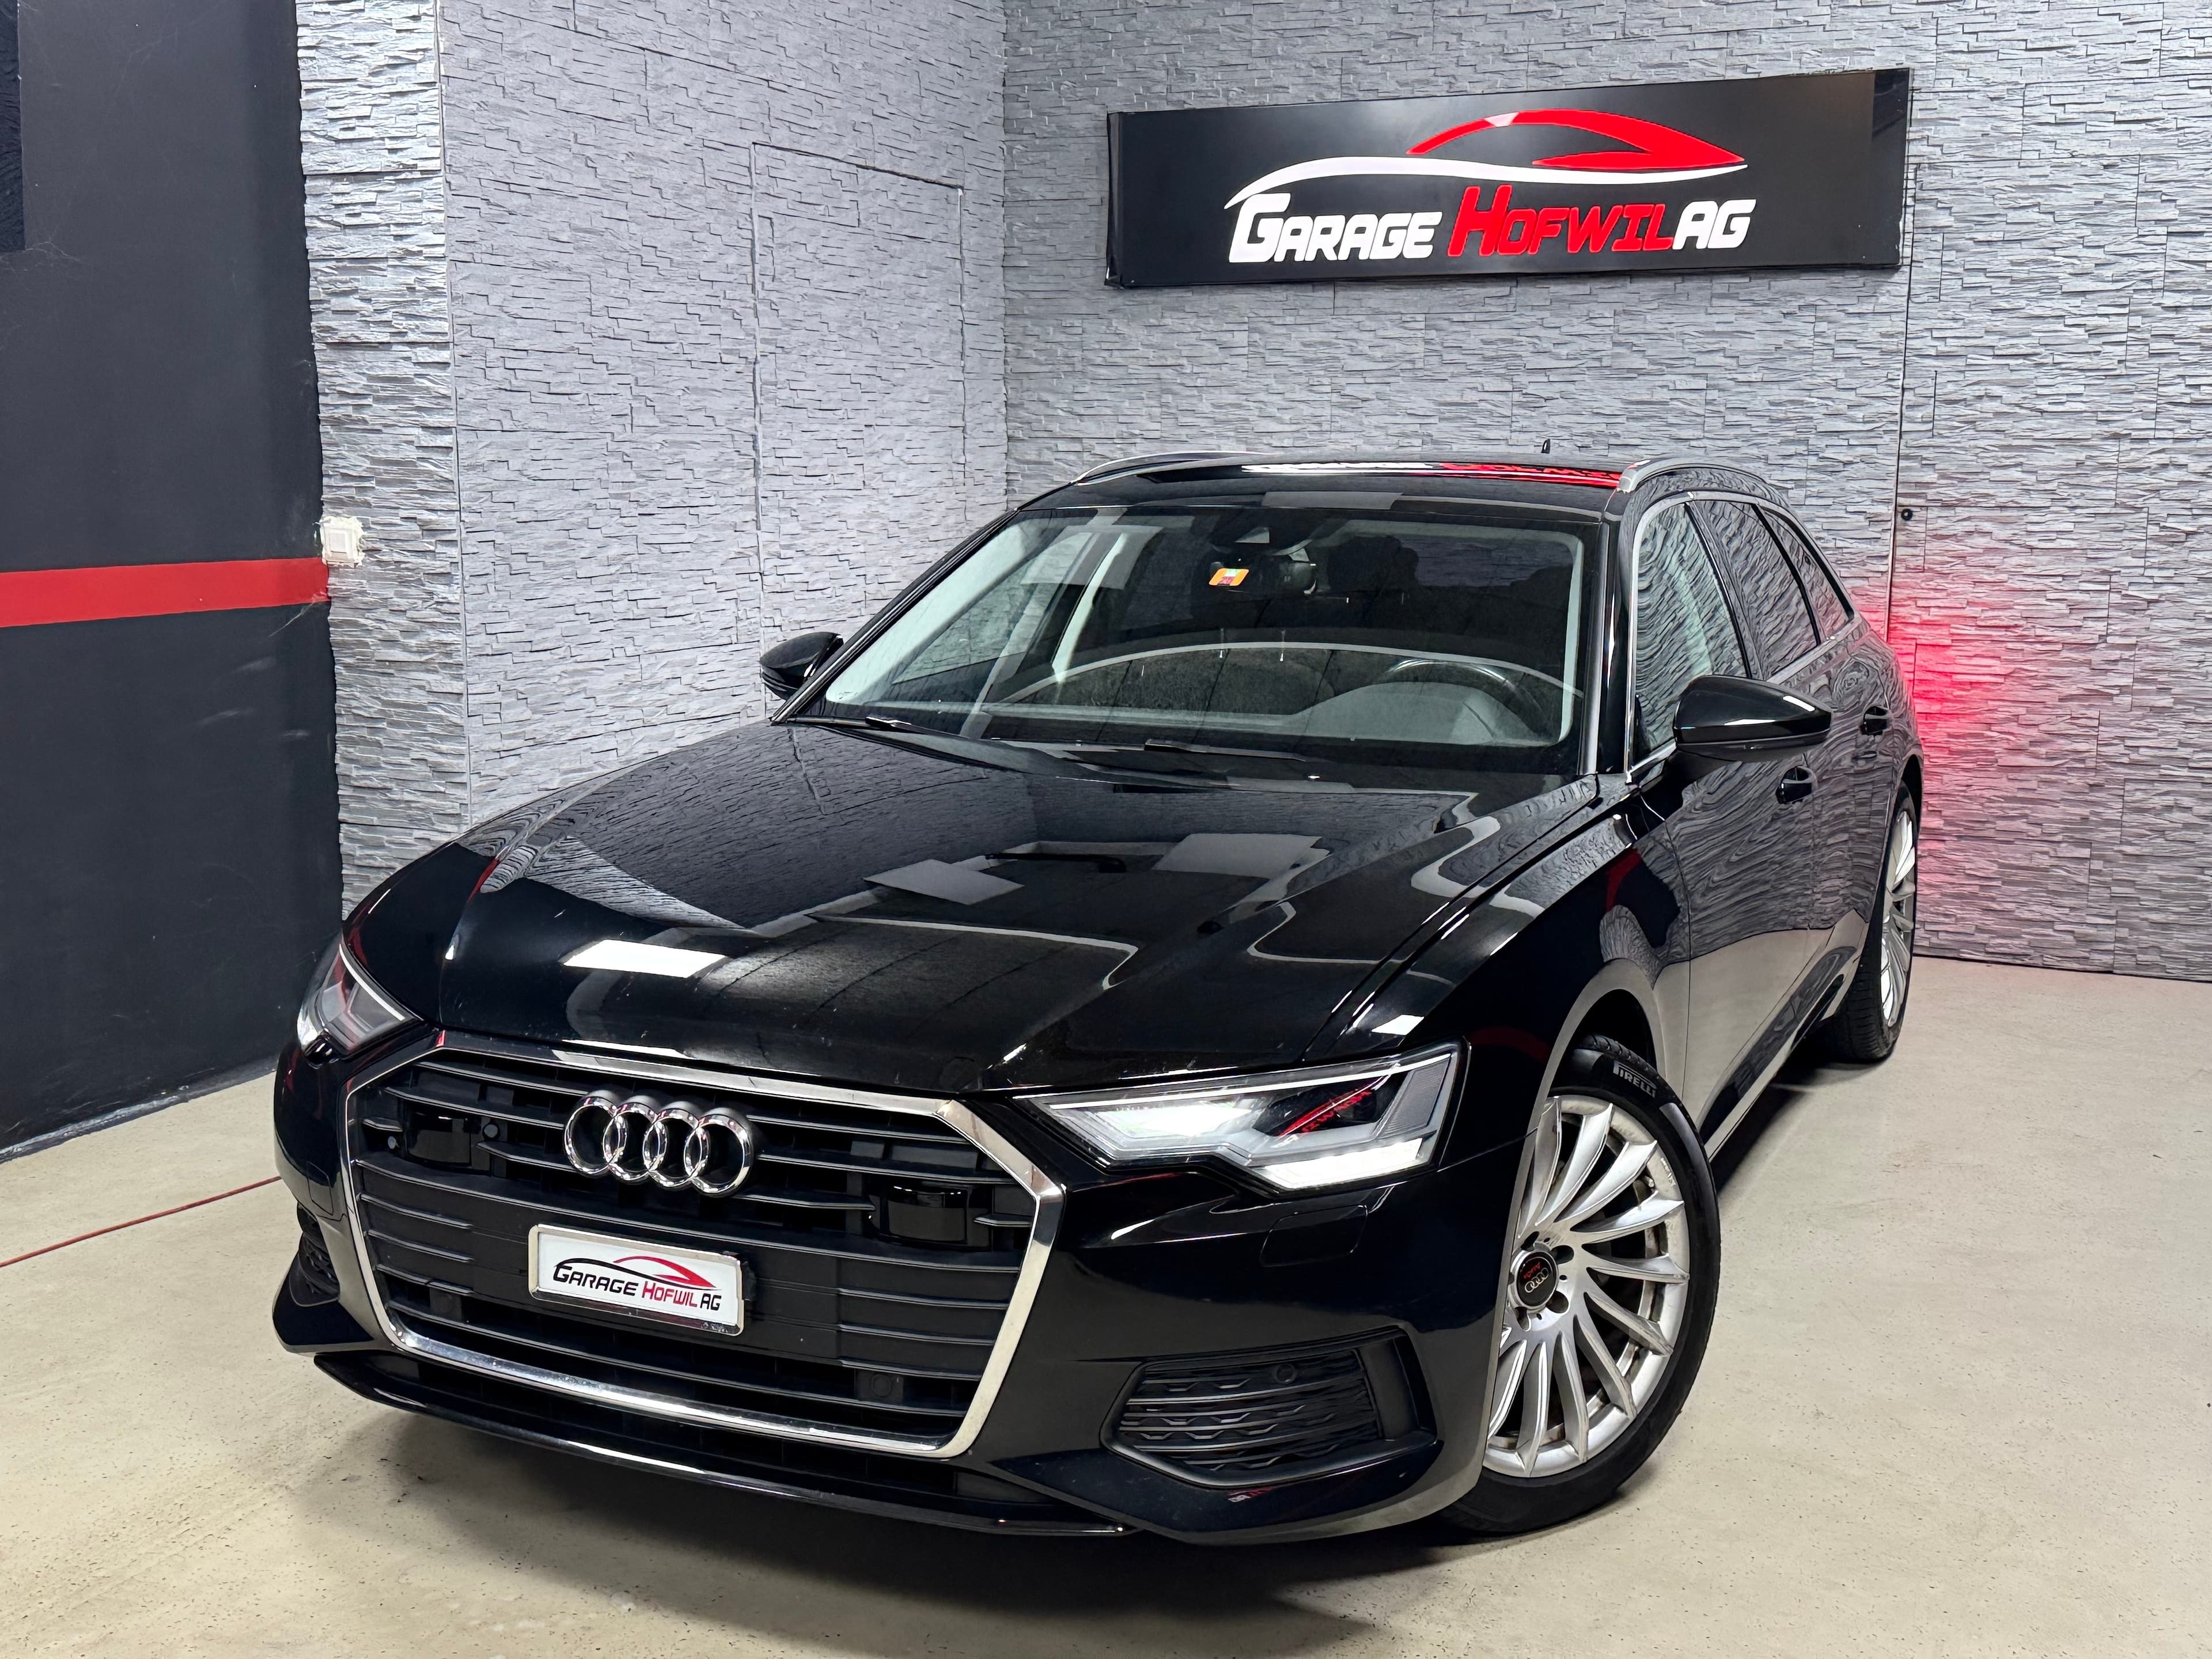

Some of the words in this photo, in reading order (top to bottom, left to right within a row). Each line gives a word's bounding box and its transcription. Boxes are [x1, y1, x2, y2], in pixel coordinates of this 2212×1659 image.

[1229, 192, 1443, 263] GARAGE
[1447, 184, 1676, 257] HOFWIL
[1672, 199, 1756, 251] AG
[1613, 1060, 1657, 1098] PIRELLI
[553, 1266, 639, 1296] GARAGE
[641, 1281, 698, 1308] HOFWIL
[699, 1293, 722, 1311] AG
